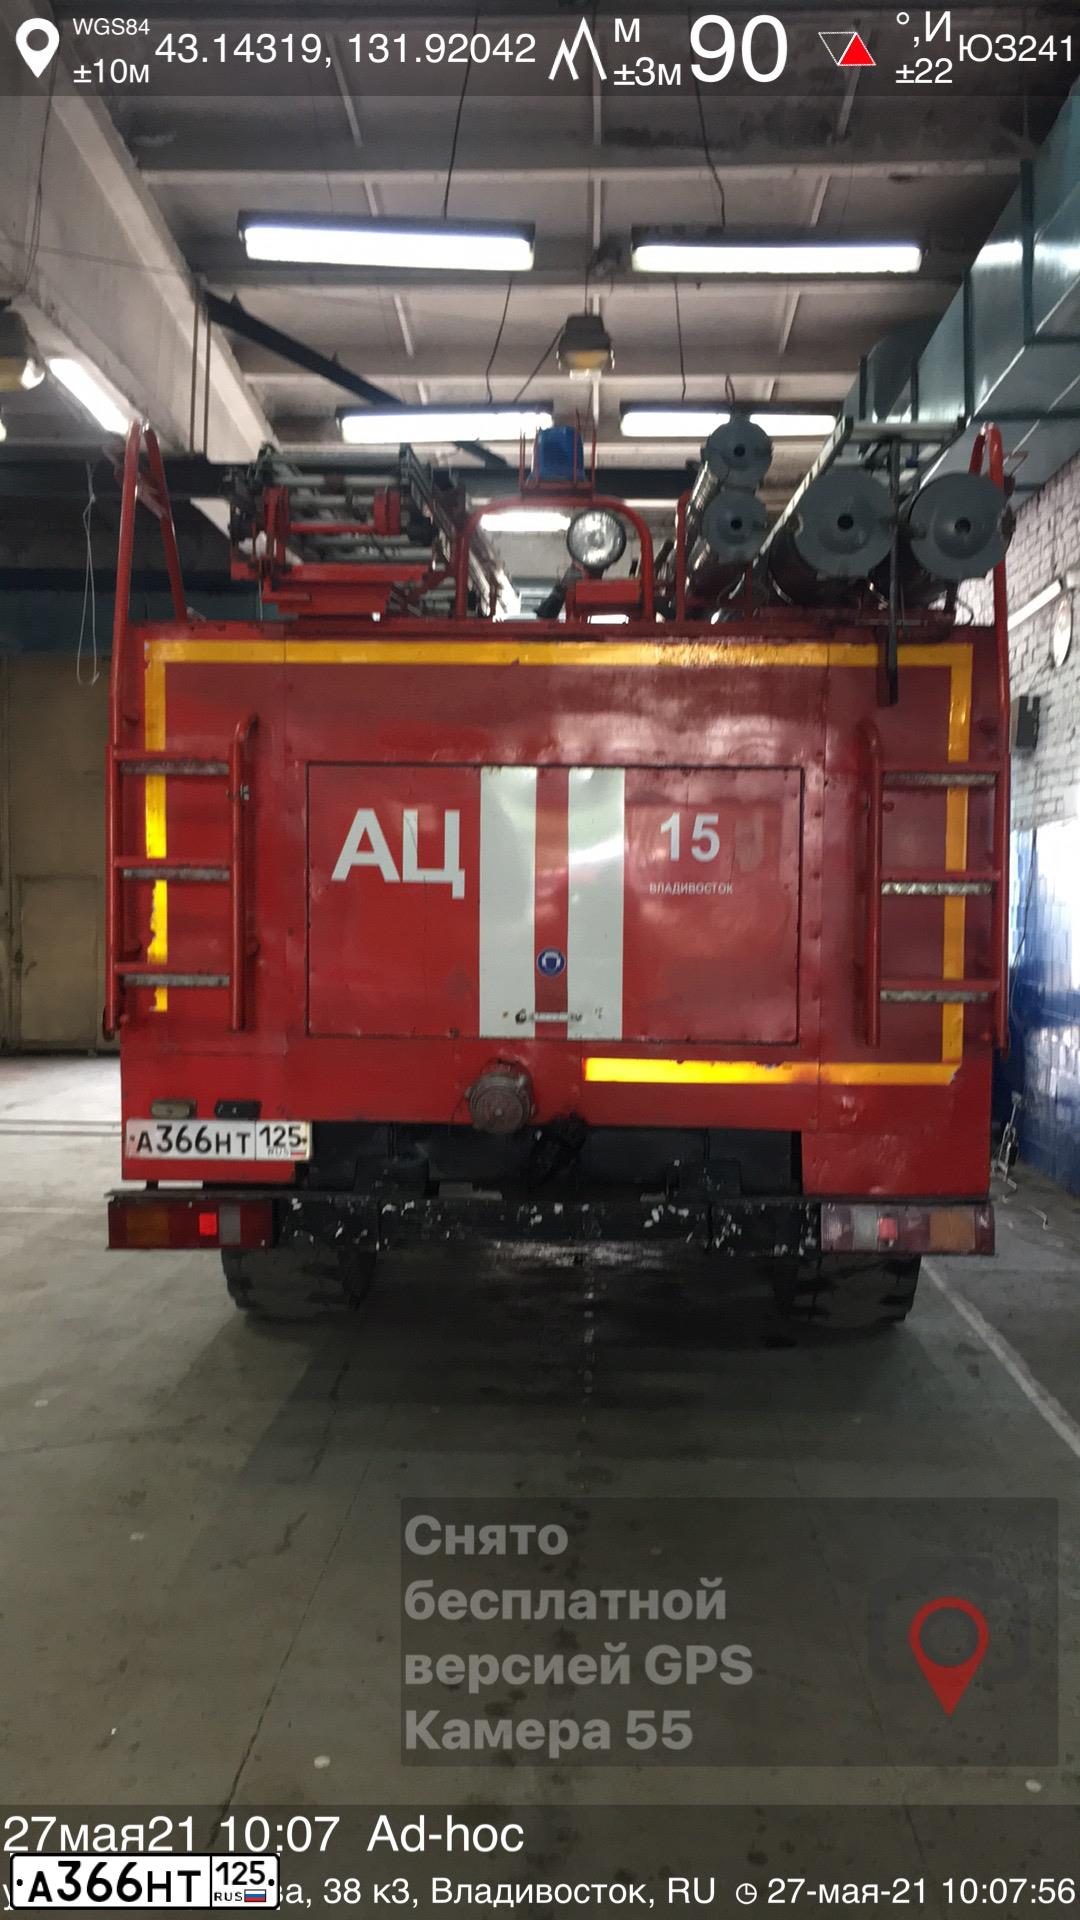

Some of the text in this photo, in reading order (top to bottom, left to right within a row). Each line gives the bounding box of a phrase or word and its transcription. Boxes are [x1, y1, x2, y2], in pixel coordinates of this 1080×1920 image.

[331, 808, 465, 900] АЦ
[660, 811, 720, 863] 15
[649, 881, 733, 895] ВЛАДИВОСТОК
[136, 1125, 302, 1154] А366НТ 125
